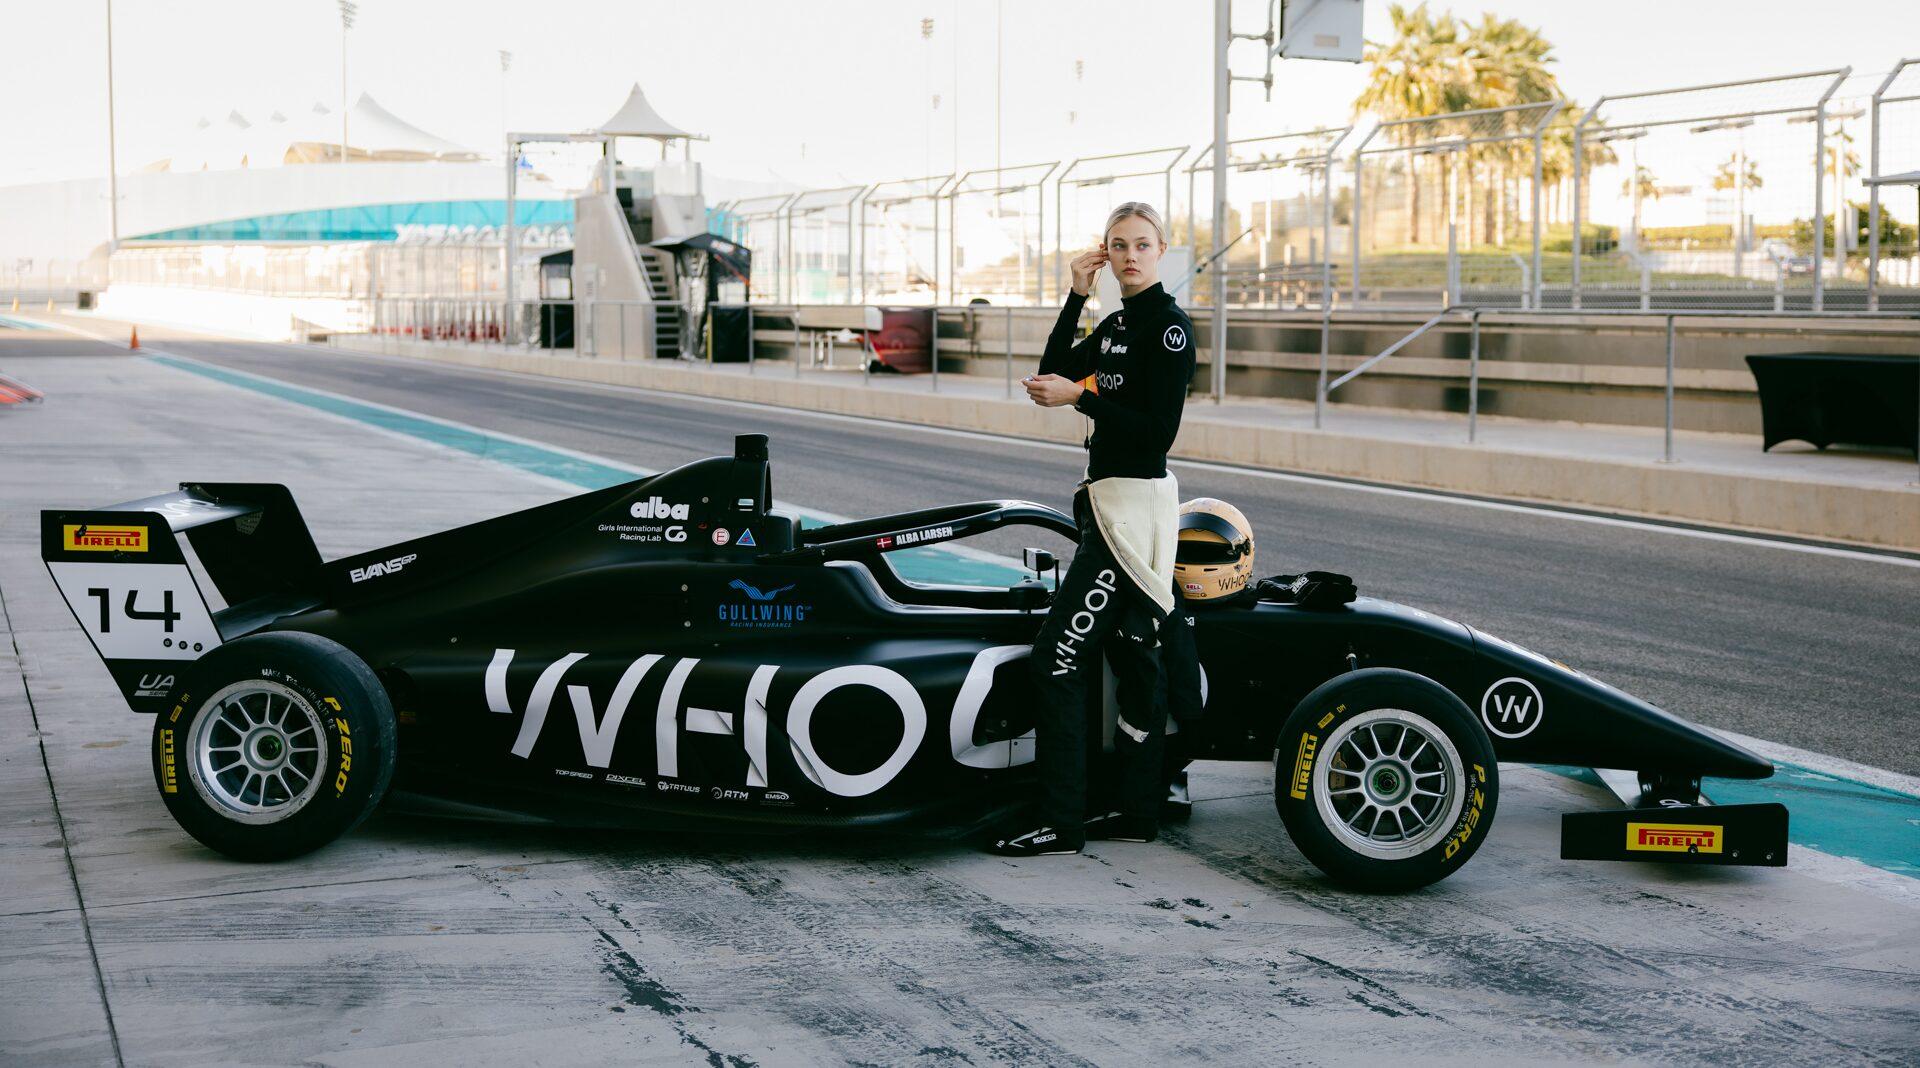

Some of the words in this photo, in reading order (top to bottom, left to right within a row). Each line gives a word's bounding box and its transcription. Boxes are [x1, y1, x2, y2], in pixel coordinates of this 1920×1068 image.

[1095, 370, 1124, 390] HOOP
[630, 496, 690, 520] alba
[74, 530, 141, 546] PIRELLI
[598, 524, 615, 532] Girls
[620, 533, 645, 542] Racing
[647, 534, 662, 542] Lab
[896, 532, 919, 546] ALBA
[920, 526, 953, 541] LARSEN
[88, 588, 181, 633] 14
[719, 604, 804, 620] GULLWING
[1052, 568, 1117, 676] WHOOP
[324, 697, 342, 711] P
[335, 717, 353, 795] ZERO
[160, 729, 178, 793] PIRELLI
[1290, 732, 1318, 801] PIRELLI
[570, 771, 593, 779] SPEED
[606, 774, 645, 785] DIXCEL
[1473, 763, 1487, 783] P
[669, 784, 700, 793] TATUUS
[1444, 788, 1486, 860] ZERO
[1033, 833, 1057, 845] sparco
[1638, 828, 1715, 848] PIRELLI
